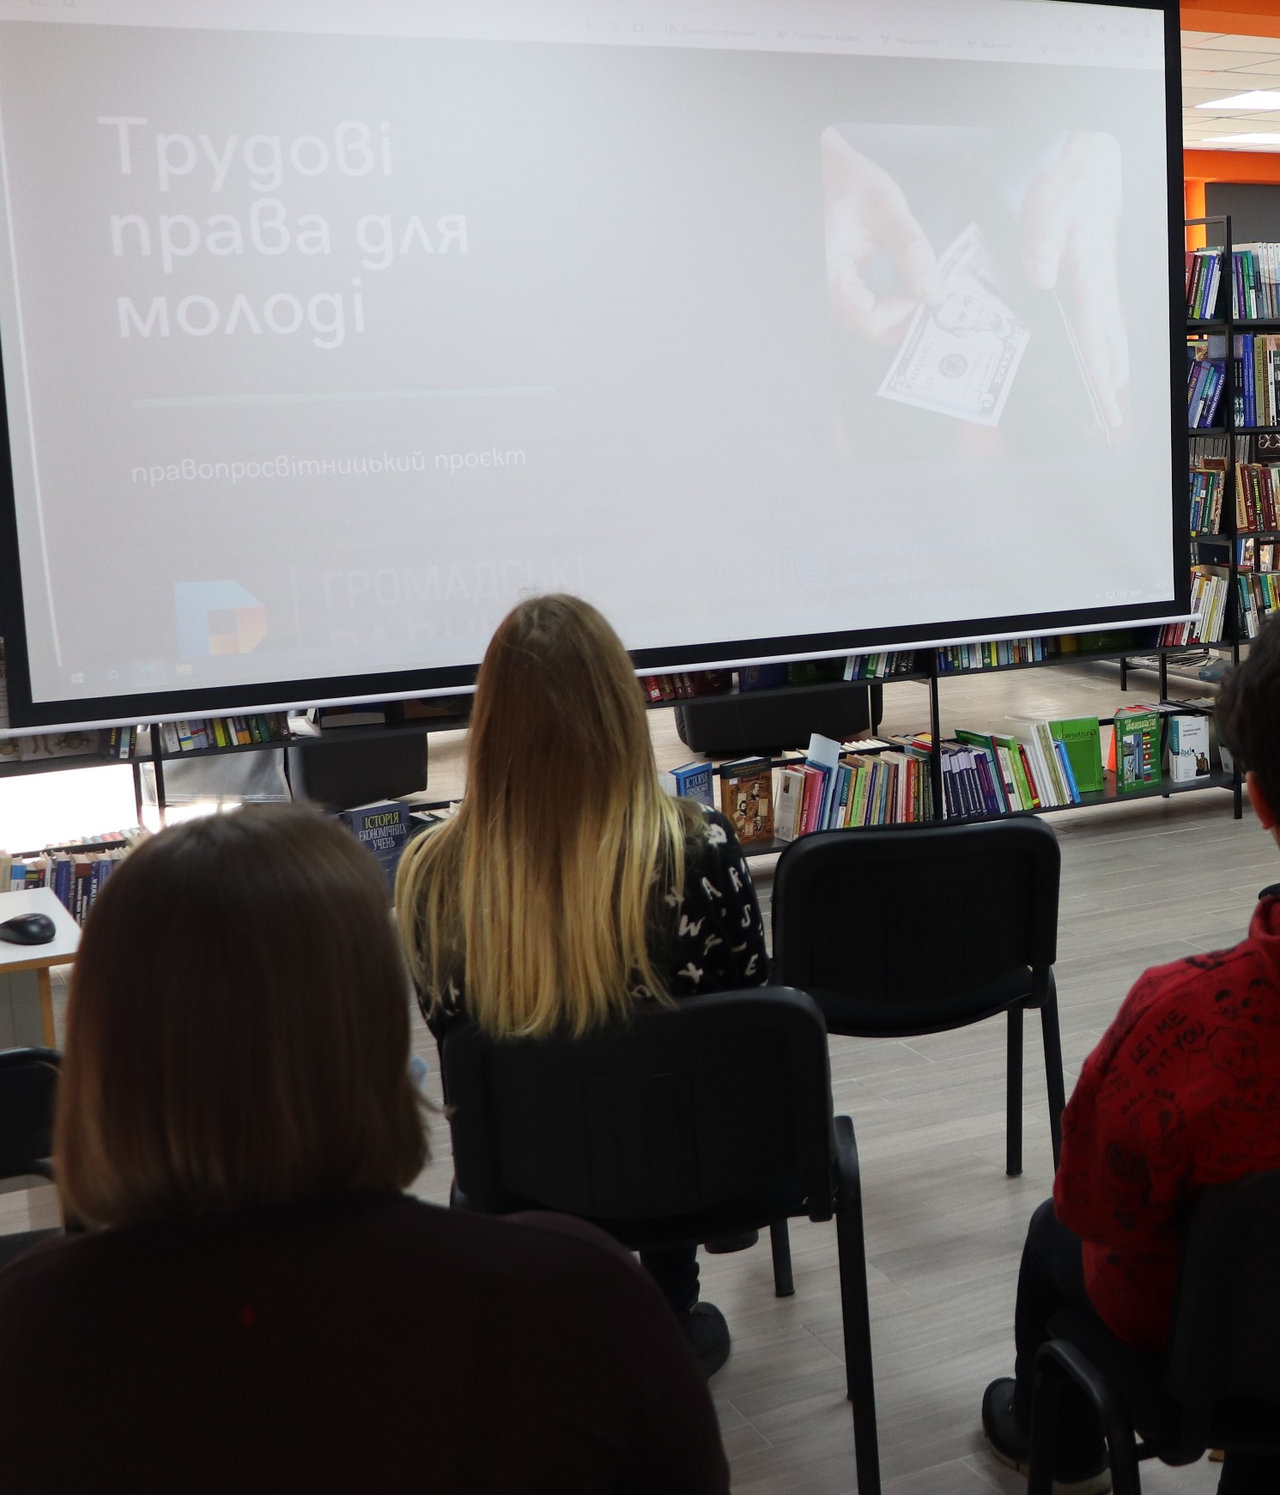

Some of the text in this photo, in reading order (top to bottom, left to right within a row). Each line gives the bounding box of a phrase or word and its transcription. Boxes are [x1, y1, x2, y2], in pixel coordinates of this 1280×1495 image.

[97, 115, 393, 193] Трудові
[109, 198, 470, 274] права для
[116, 276, 365, 350] молоді
[132, 451, 426, 486] правопросвітницький
[359, 823, 407, 841] ЕКОНОМІЧНИХ
[364, 811, 399, 829] ІСТОРІЯ
[372, 836, 396, 850] УЧЕНЬ
[1130, 1009, 1188, 1064] LET ME
[1171, 1020, 1206, 1051] YOU
